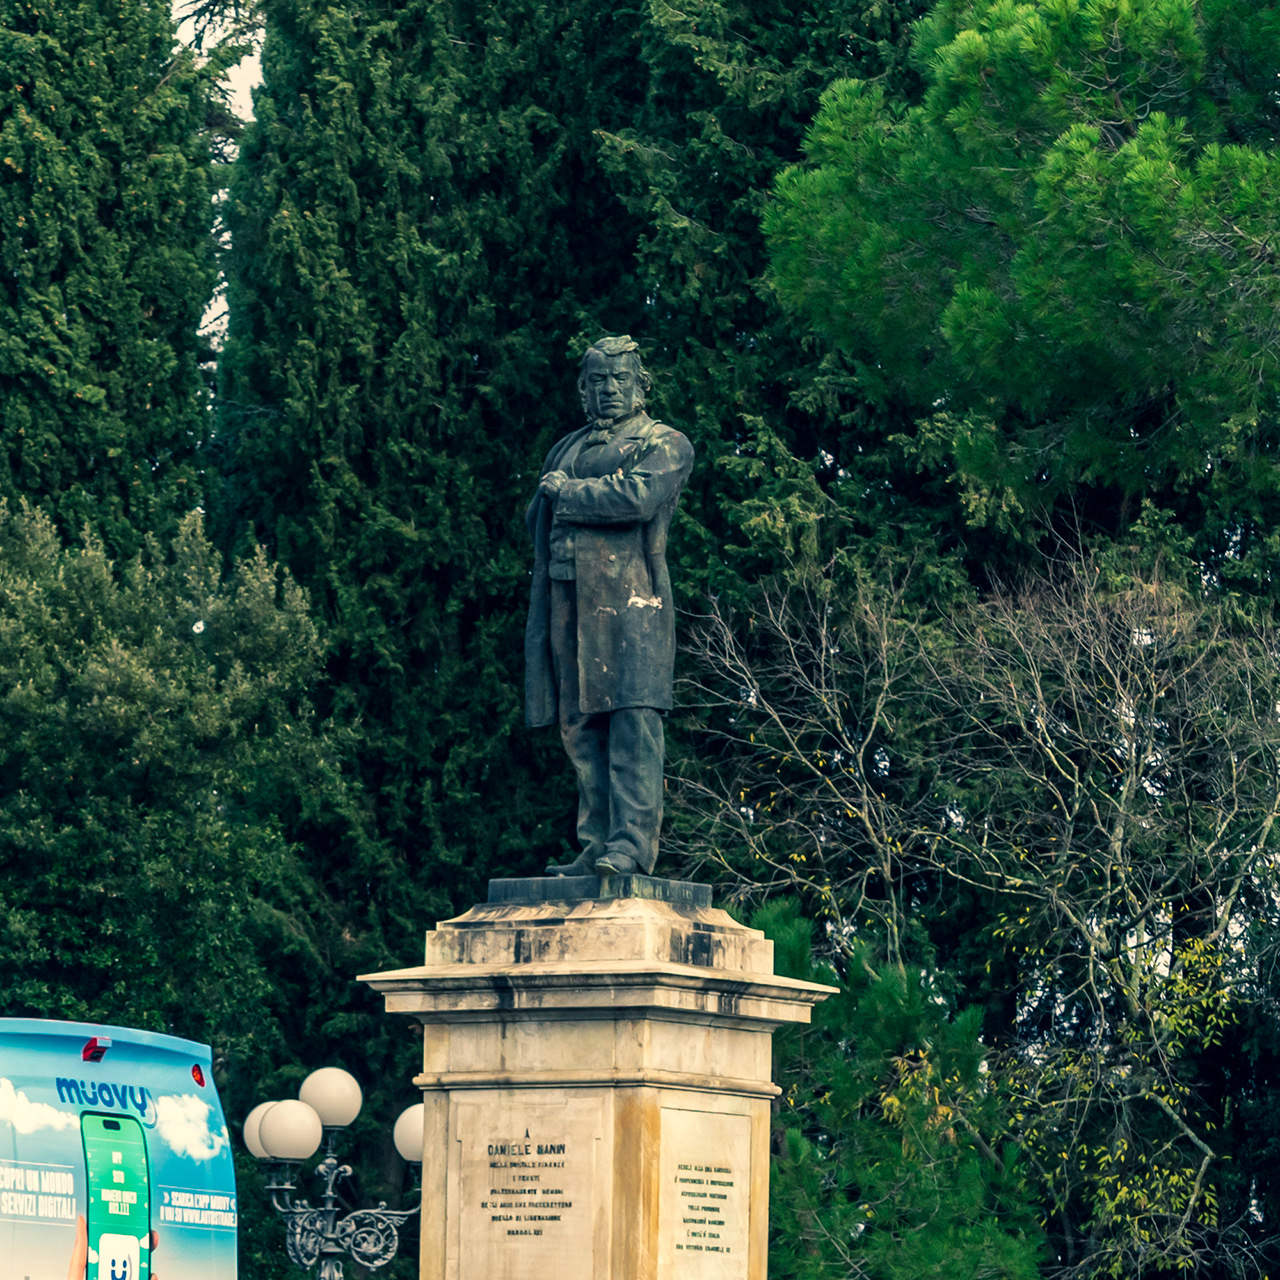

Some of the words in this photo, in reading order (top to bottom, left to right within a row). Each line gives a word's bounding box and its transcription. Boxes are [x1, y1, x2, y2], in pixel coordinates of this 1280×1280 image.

[487, 1144, 531, 1156] DANIELE
[26, 1169, 40, 1192] UN
[41, 1170, 74, 1195] MONDO
[1, 1191, 36, 1216] SERVIZI
[38, 1194, 76, 1219] DIGITALI
